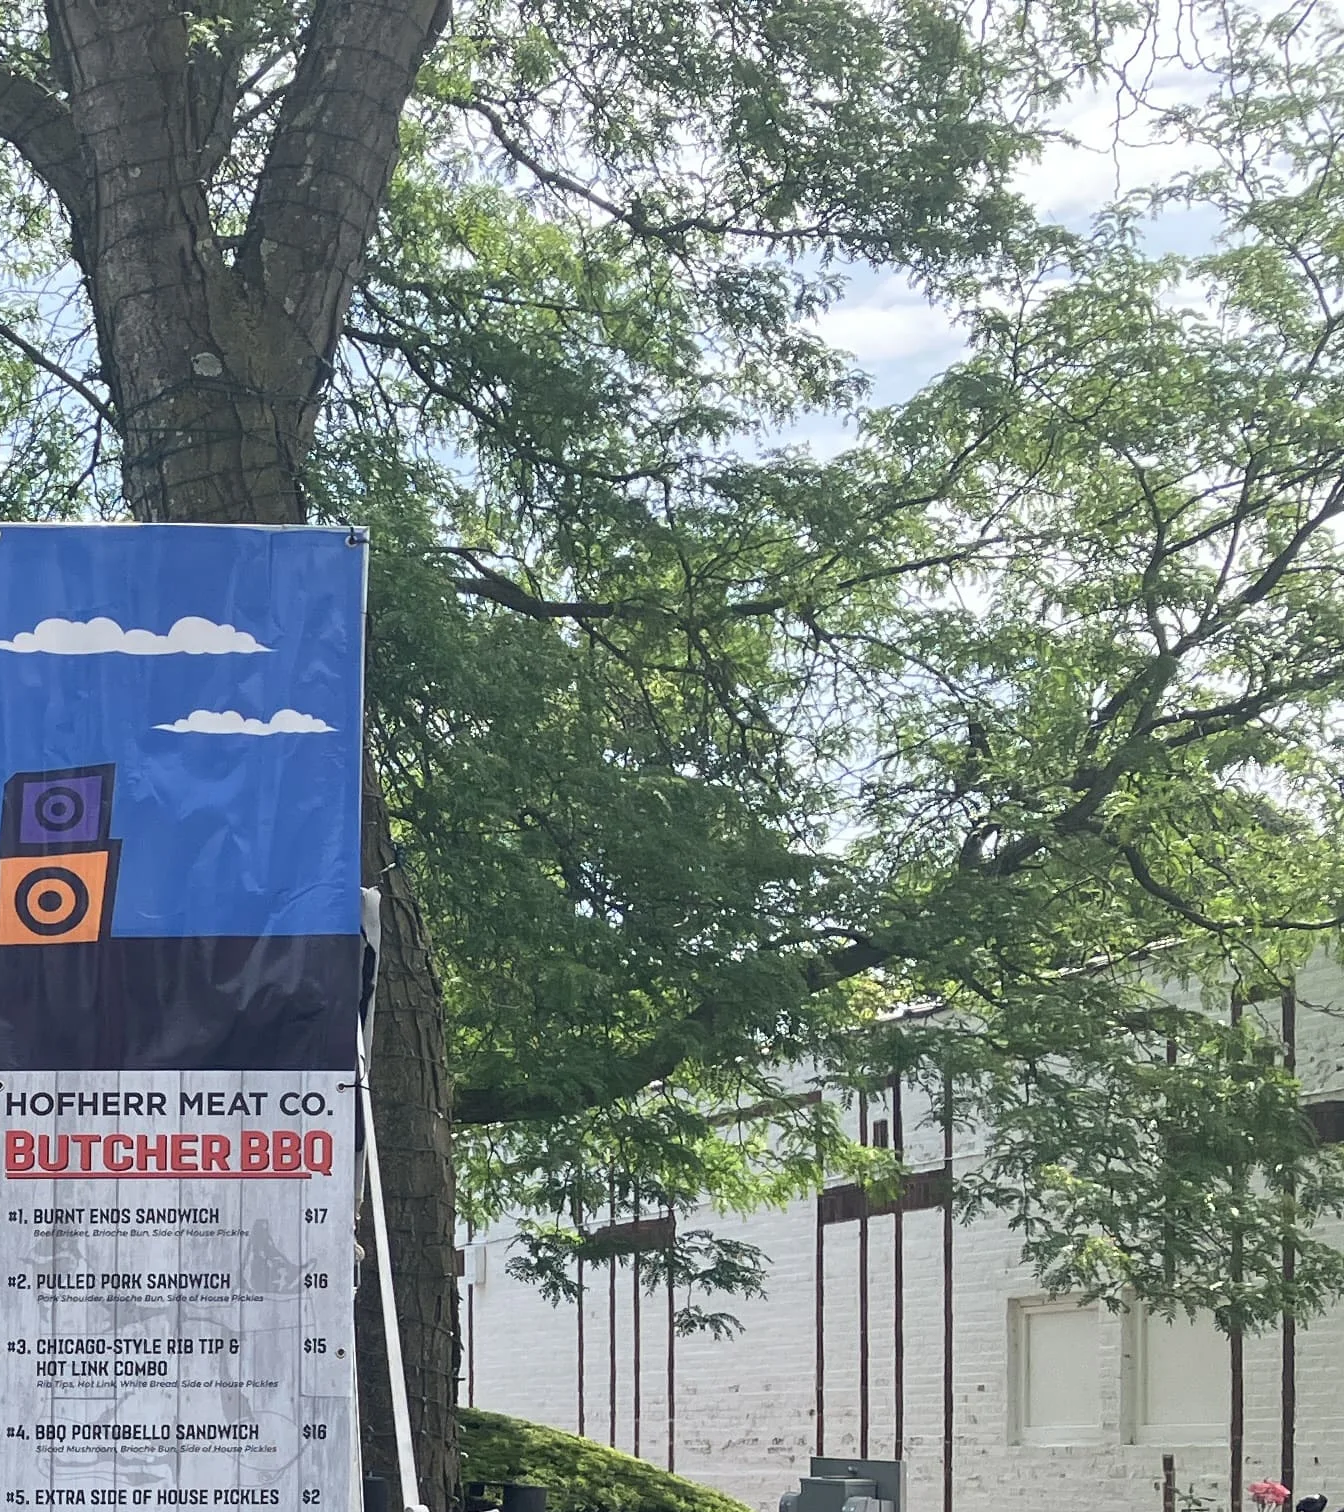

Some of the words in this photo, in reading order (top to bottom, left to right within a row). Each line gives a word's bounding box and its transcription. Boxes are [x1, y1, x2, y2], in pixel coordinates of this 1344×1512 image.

[6, 1092, 167, 1116] HOFHERR
[180, 1092, 267, 1116] MEAT
[280, 1092, 334, 1116] CO.
[5, 1130, 231, 1172] BUTCHER
[241, 1130, 332, 1176] BBQ
[8, 1209, 28, 1224] #1.
[34, 1208, 85, 1224] BURNT
[90, 1208, 131, 1224] ENDS
[136, 1208, 219, 1224] SANDWICH
[305, 1208, 328, 1224] $17
[8, 1274, 31, 1290] #2.
[37, 1273, 96, 1290] PULLED
[101, 1273, 142, 1290] PORK
[147, 1273, 230, 1290] SANDWICH
[304, 1273, 328, 1289] $16
[7, 1339, 31, 1355] #3.
[37, 1338, 161, 1355] CHICAGO-STYLE
[167, 1338, 193, 1355] RIB
[199, 1338, 224, 1354] TIP
[229, 1338, 239, 1354] &
[304, 1338, 327, 1354] $15
[36, 1360, 67, 1377] HOT
[72, 1360, 109, 1377] LINK
[114, 1360, 168, 1377] COMBO
[7, 1425, 30, 1441] #4.
[36, 1424, 66, 1442] BBQ
[72, 1424, 170, 1441] PORTOBELLO
[176, 1424, 259, 1440] SANDWICH
[303, 1424, 327, 1440] $16
[6, 1489, 29, 1505] #5.
[36, 1489, 85, 1505] EXTRA
[91, 1489, 128, 1505] SIDE
[132, 1489, 152, 1505] OF
[158, 1489, 209, 1505] HOUSE
[214, 1489, 279, 1505] PICKLES
[302, 1489, 321, 1505] $2
